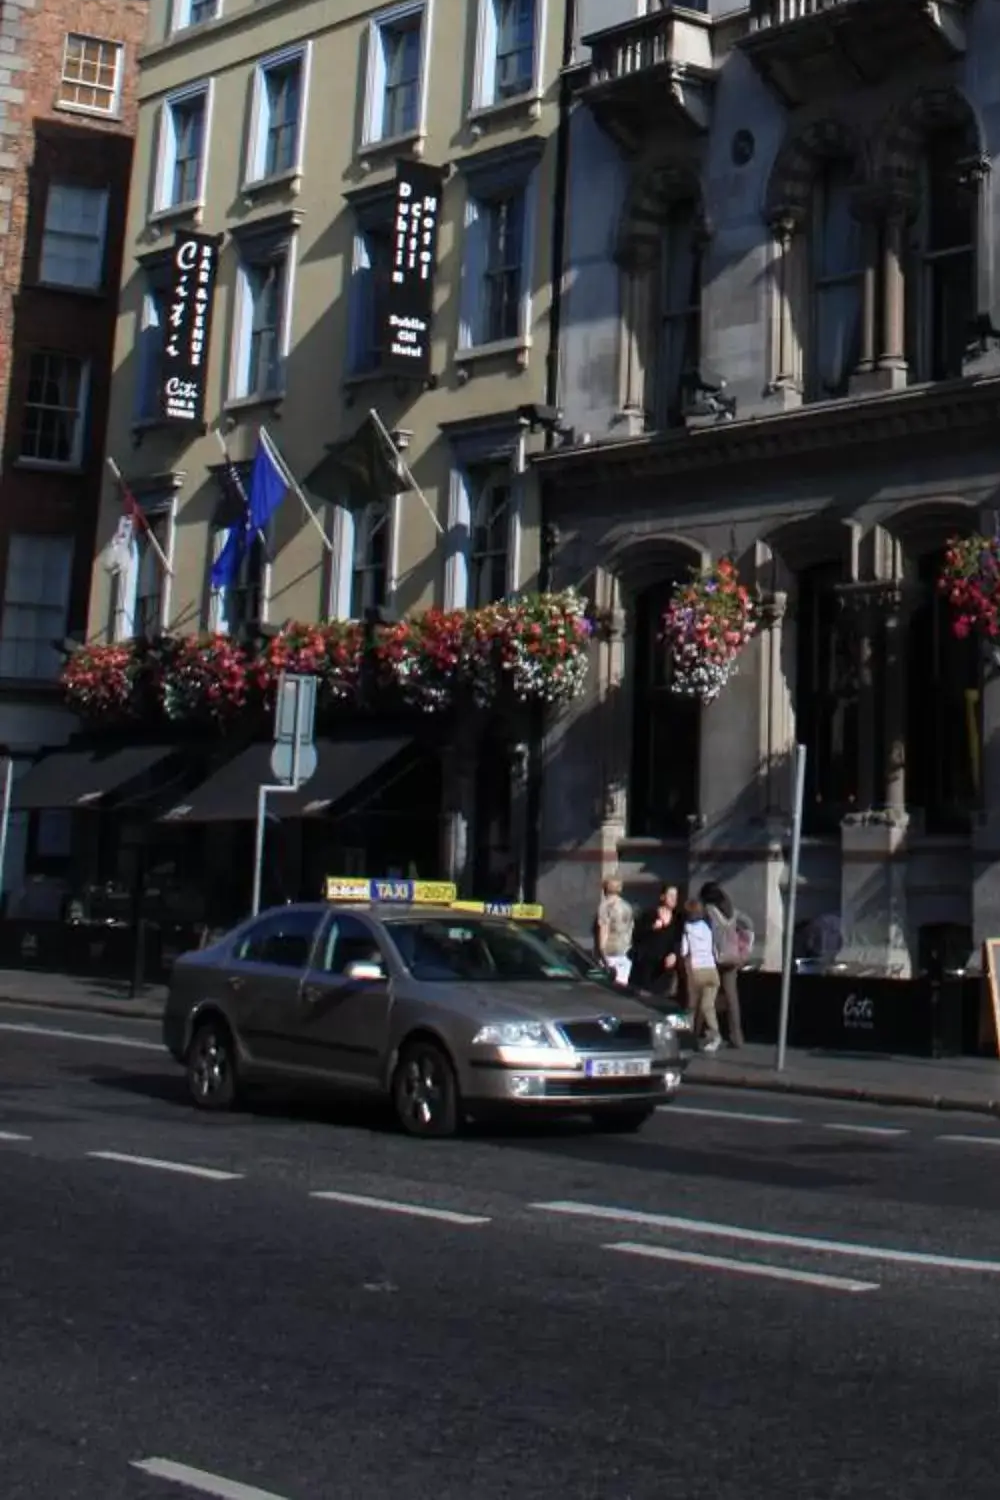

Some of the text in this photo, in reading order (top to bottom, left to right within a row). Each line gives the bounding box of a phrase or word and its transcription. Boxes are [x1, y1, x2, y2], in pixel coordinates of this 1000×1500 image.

[392, 181, 412, 283] Dublin
[408, 203, 422, 269] Citi
[420, 195, 437, 280] Hotel
[166, 241, 197, 357] Citi
[190, 245, 212, 366] BAR & VENUE
[391, 342, 423, 357] Hotel
[166, 377, 198, 398] Citi
[375, 881, 409, 899] TAXI
[485, 902, 511, 916] TAXI
